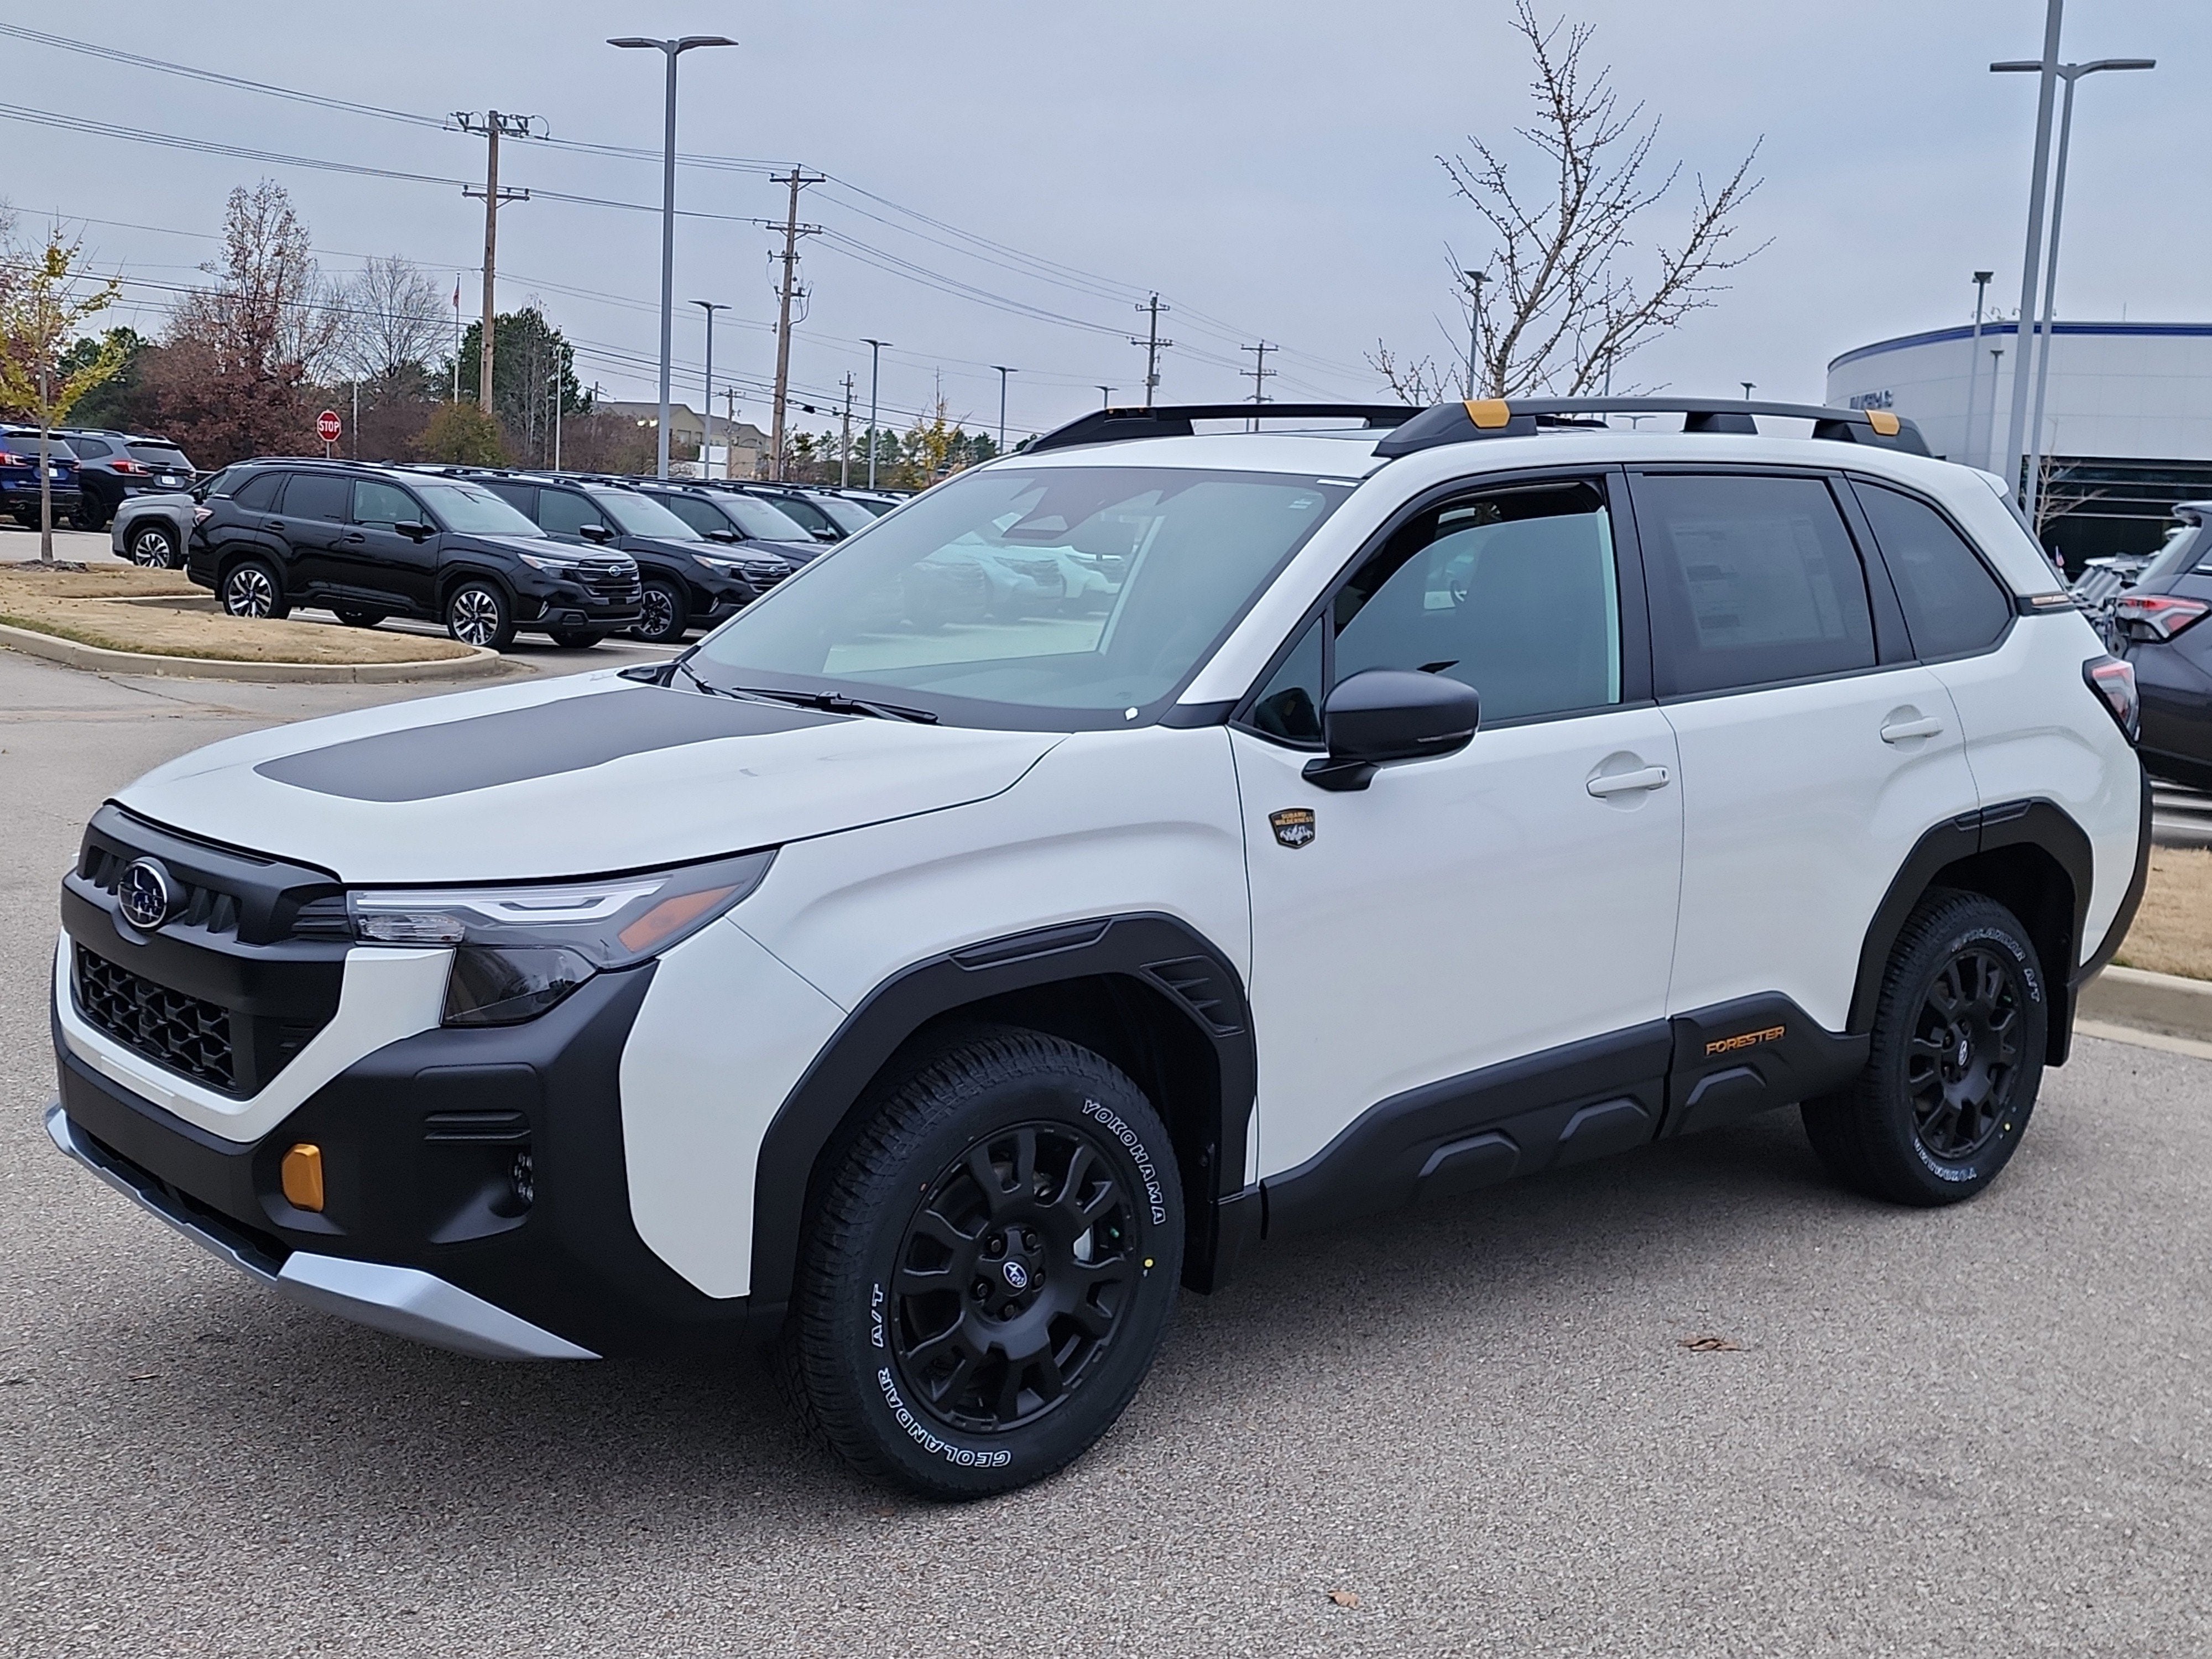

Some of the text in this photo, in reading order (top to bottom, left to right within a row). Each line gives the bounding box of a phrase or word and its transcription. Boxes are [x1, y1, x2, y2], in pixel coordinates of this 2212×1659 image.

[319, 420, 340, 432] STOP
[1705, 1025, 1785, 1056] FORESTER
[1082, 1099, 1166, 1225] YOKOHAMA
[870, 1283, 1011, 1467] GEOLANDAR A/T
